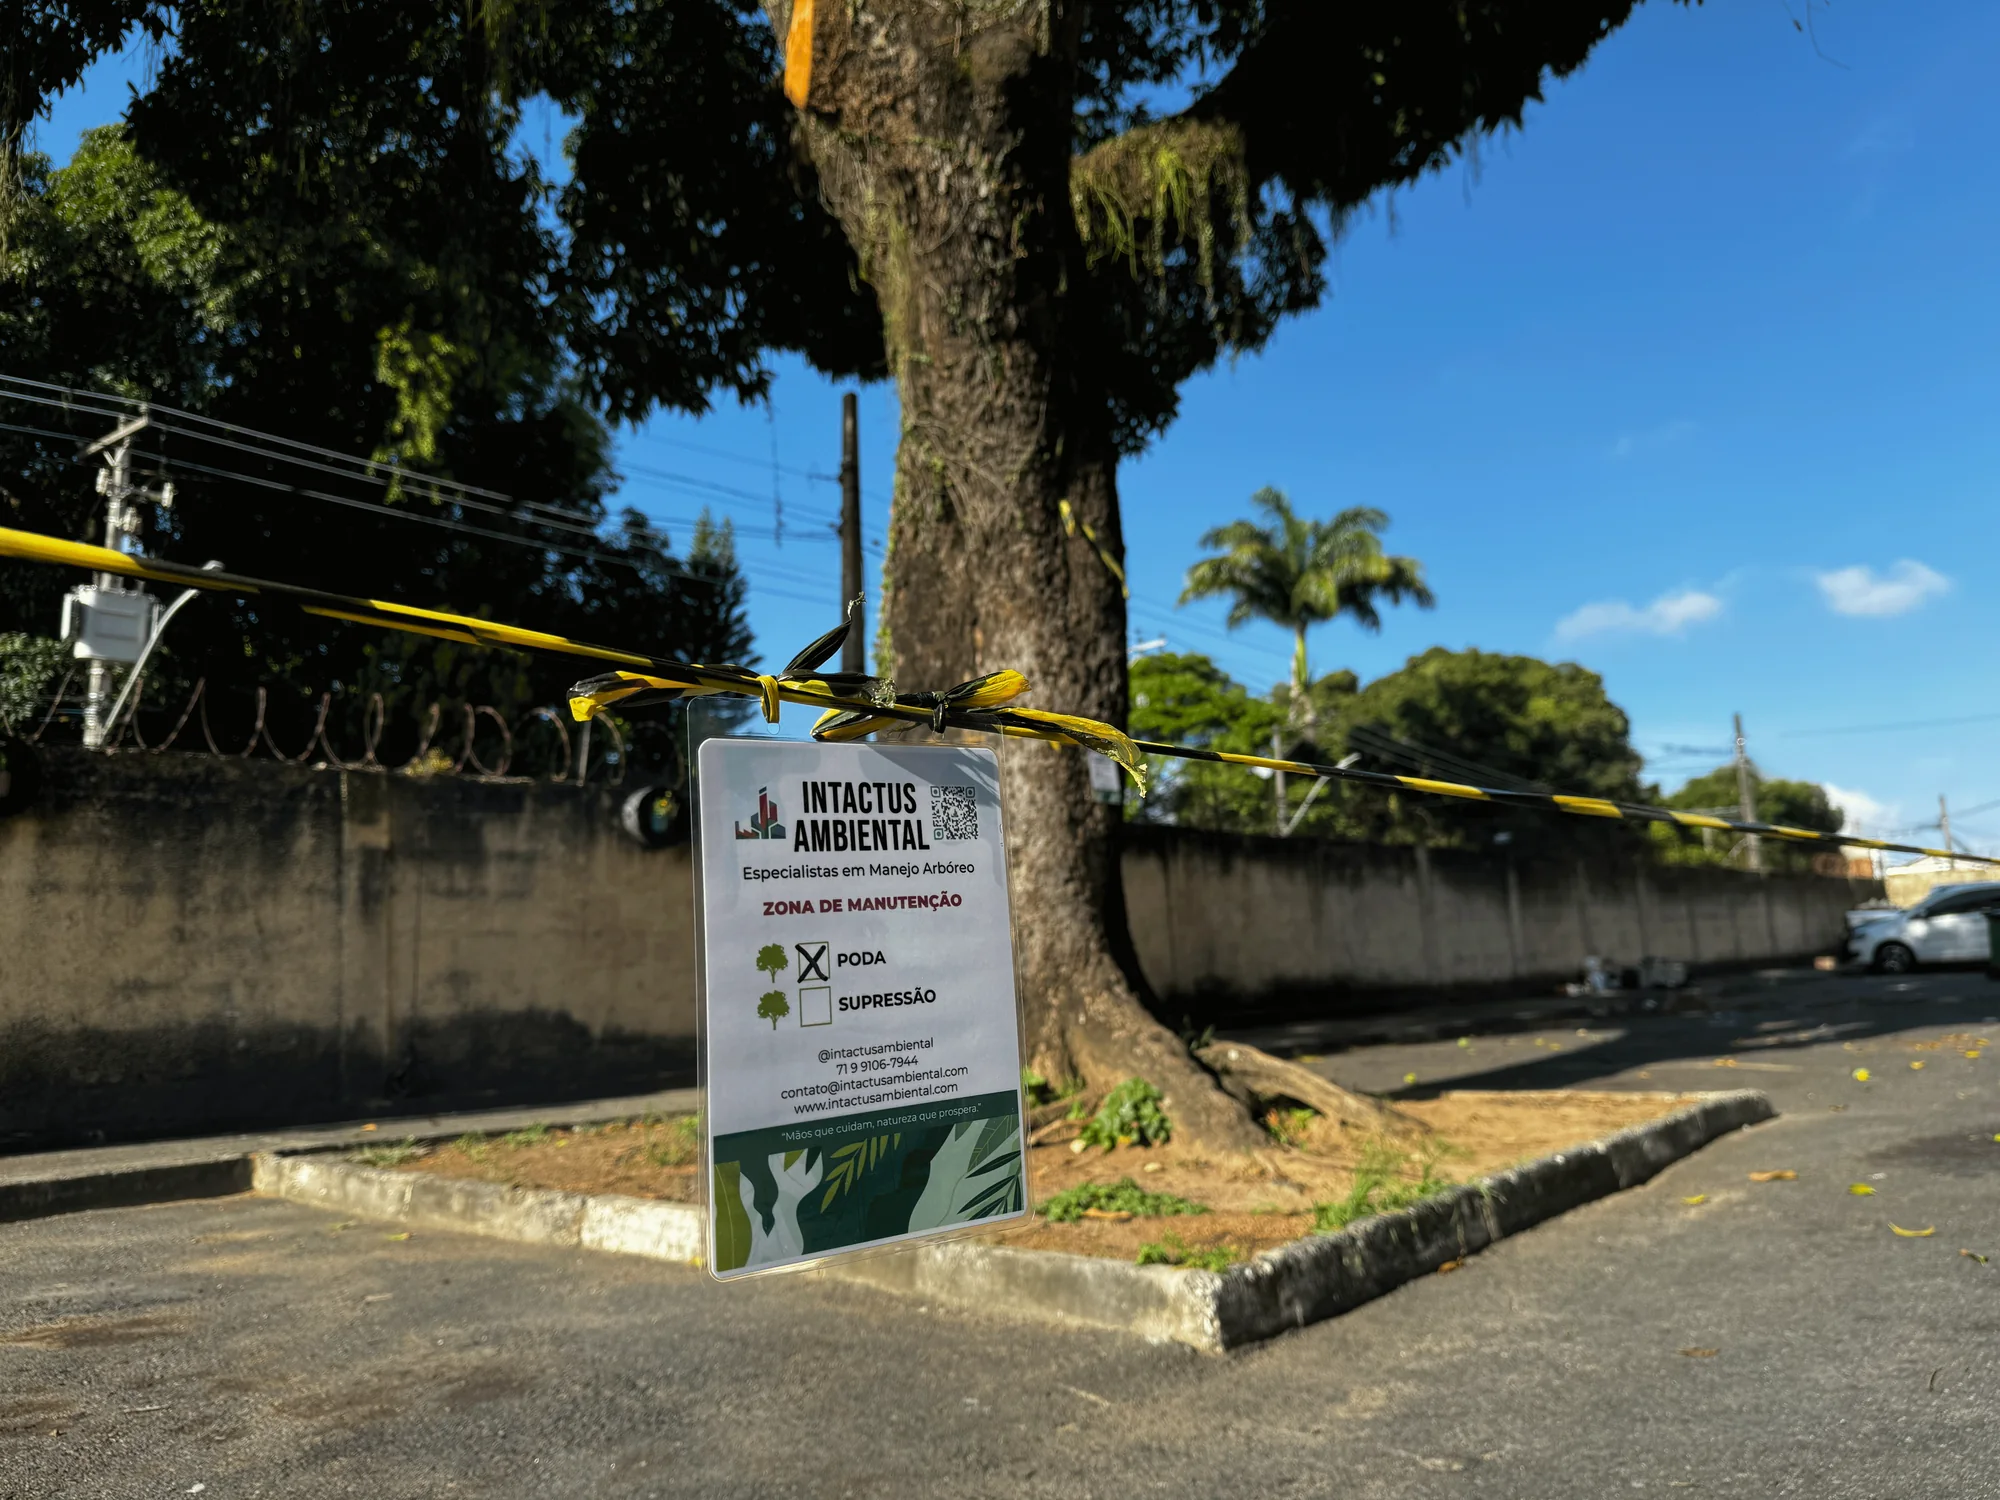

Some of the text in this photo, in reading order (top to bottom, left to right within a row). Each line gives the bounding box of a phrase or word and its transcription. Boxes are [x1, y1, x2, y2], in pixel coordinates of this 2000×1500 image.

[802, 781, 917, 814] INTACTUS
[794, 819, 930, 852] AMBIENTAL
[743, 861, 975, 882] Especialistas em Manejo Arbóreo
[763, 891, 962, 916] ZONA DE MANUTENÇÃO
[837, 950, 887, 968] PODA
[838, 987, 936, 1012] SUPRESSÃO
[818, 1037, 934, 1063] @intactusambiental
[836, 1055, 919, 1076] 71 9 9106-7944
[780, 1065, 969, 1100] contato@intactusambiental.com
[793, 1082, 958, 1115] www.intactusambiental.com
[814, 1127, 833, 1139] que
[835, 1119, 875, 1134] cuidam,
[876, 1115, 917, 1129] natureza
[918, 1111, 937, 1124] que
